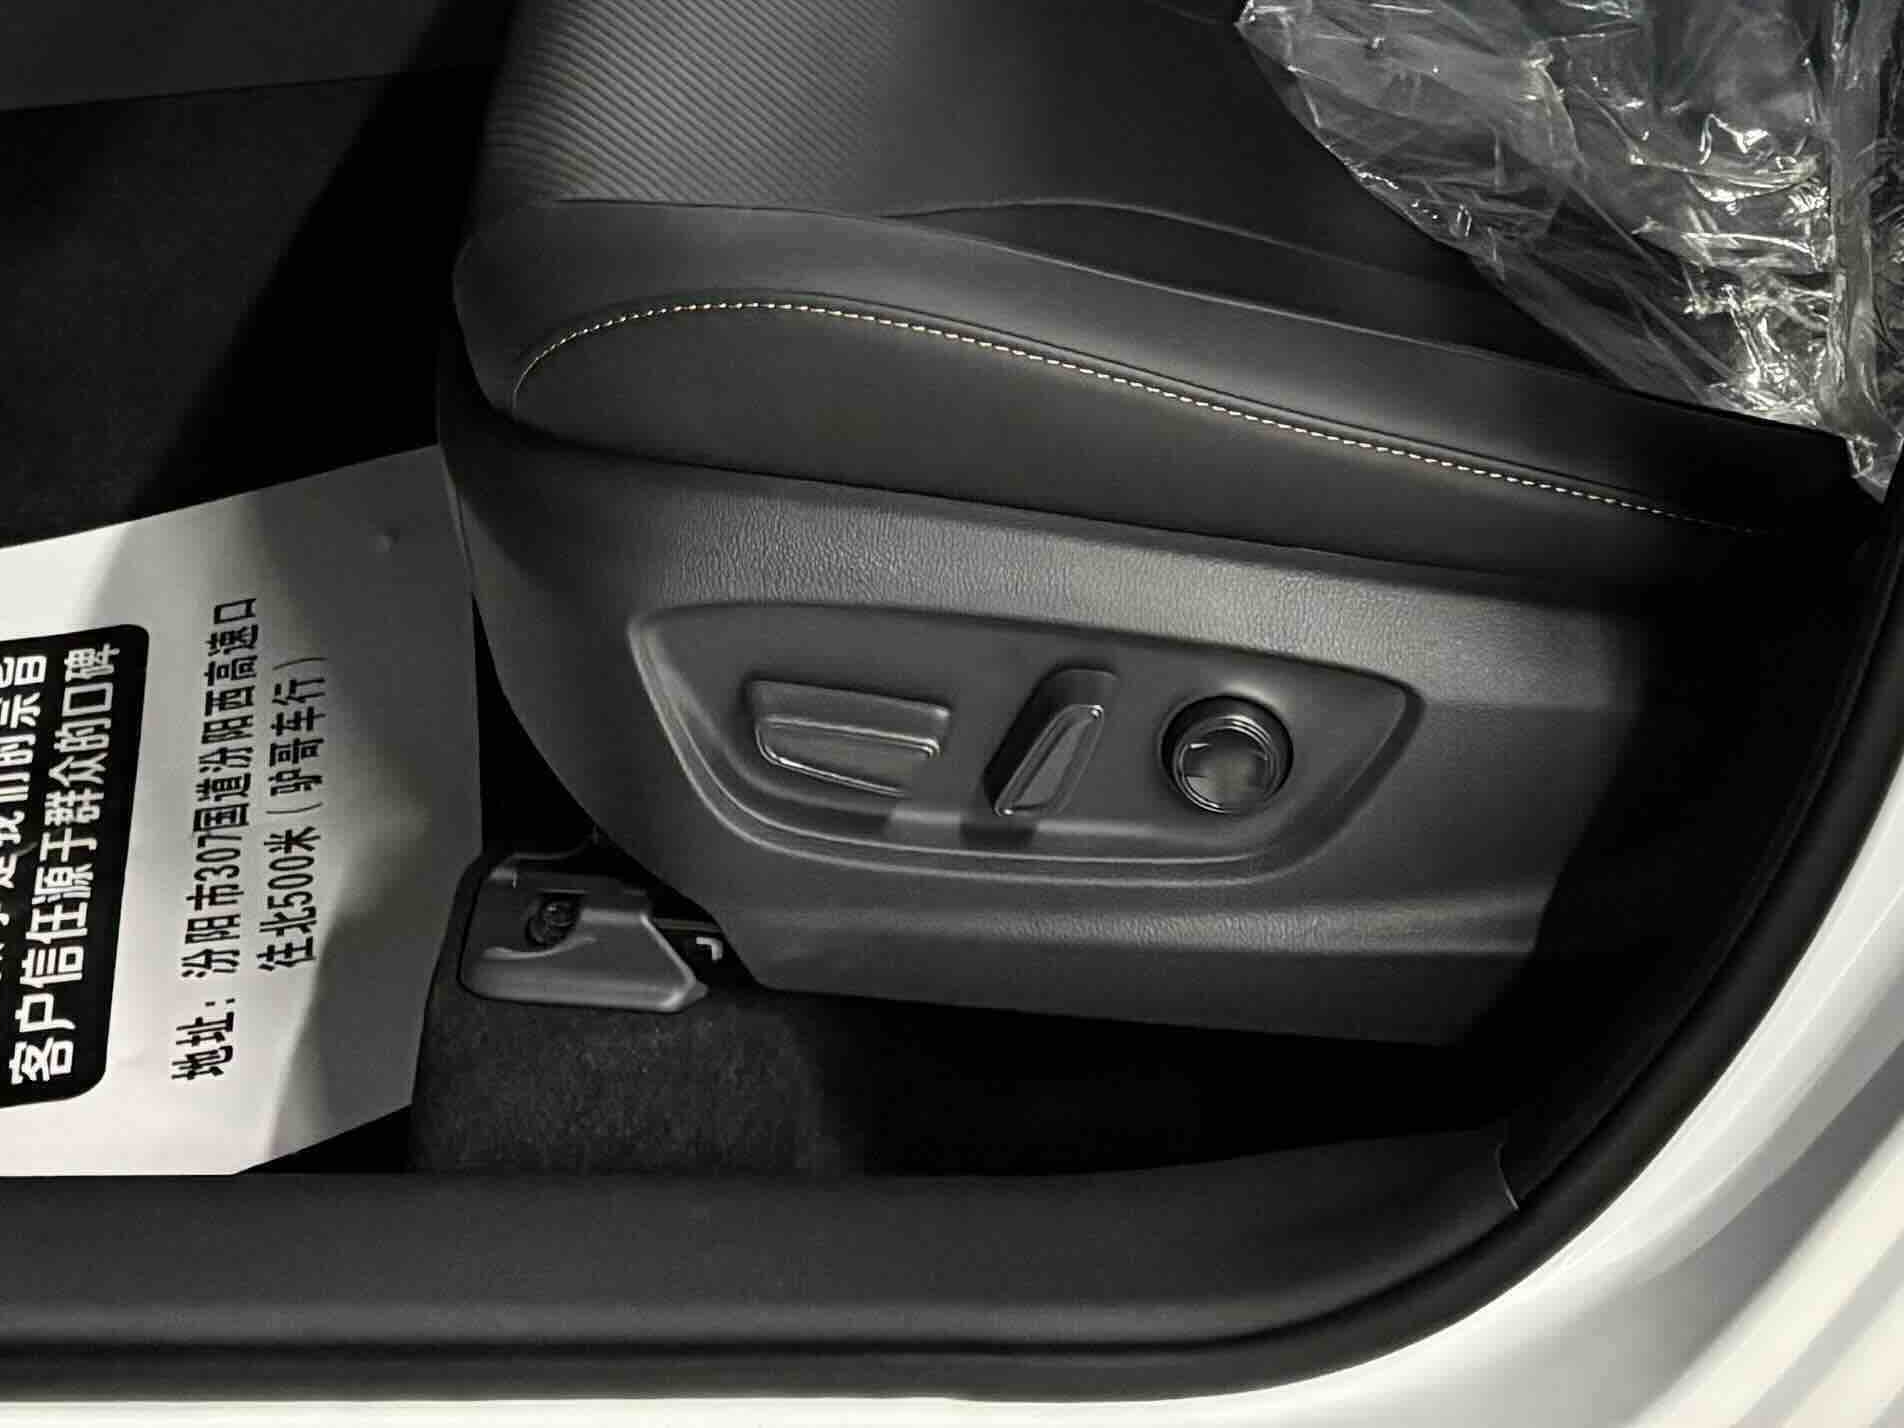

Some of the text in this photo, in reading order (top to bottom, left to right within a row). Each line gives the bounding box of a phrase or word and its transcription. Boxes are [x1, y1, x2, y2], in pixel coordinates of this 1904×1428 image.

[9, 643, 121, 1085] 客户信任源于群众的口碑
